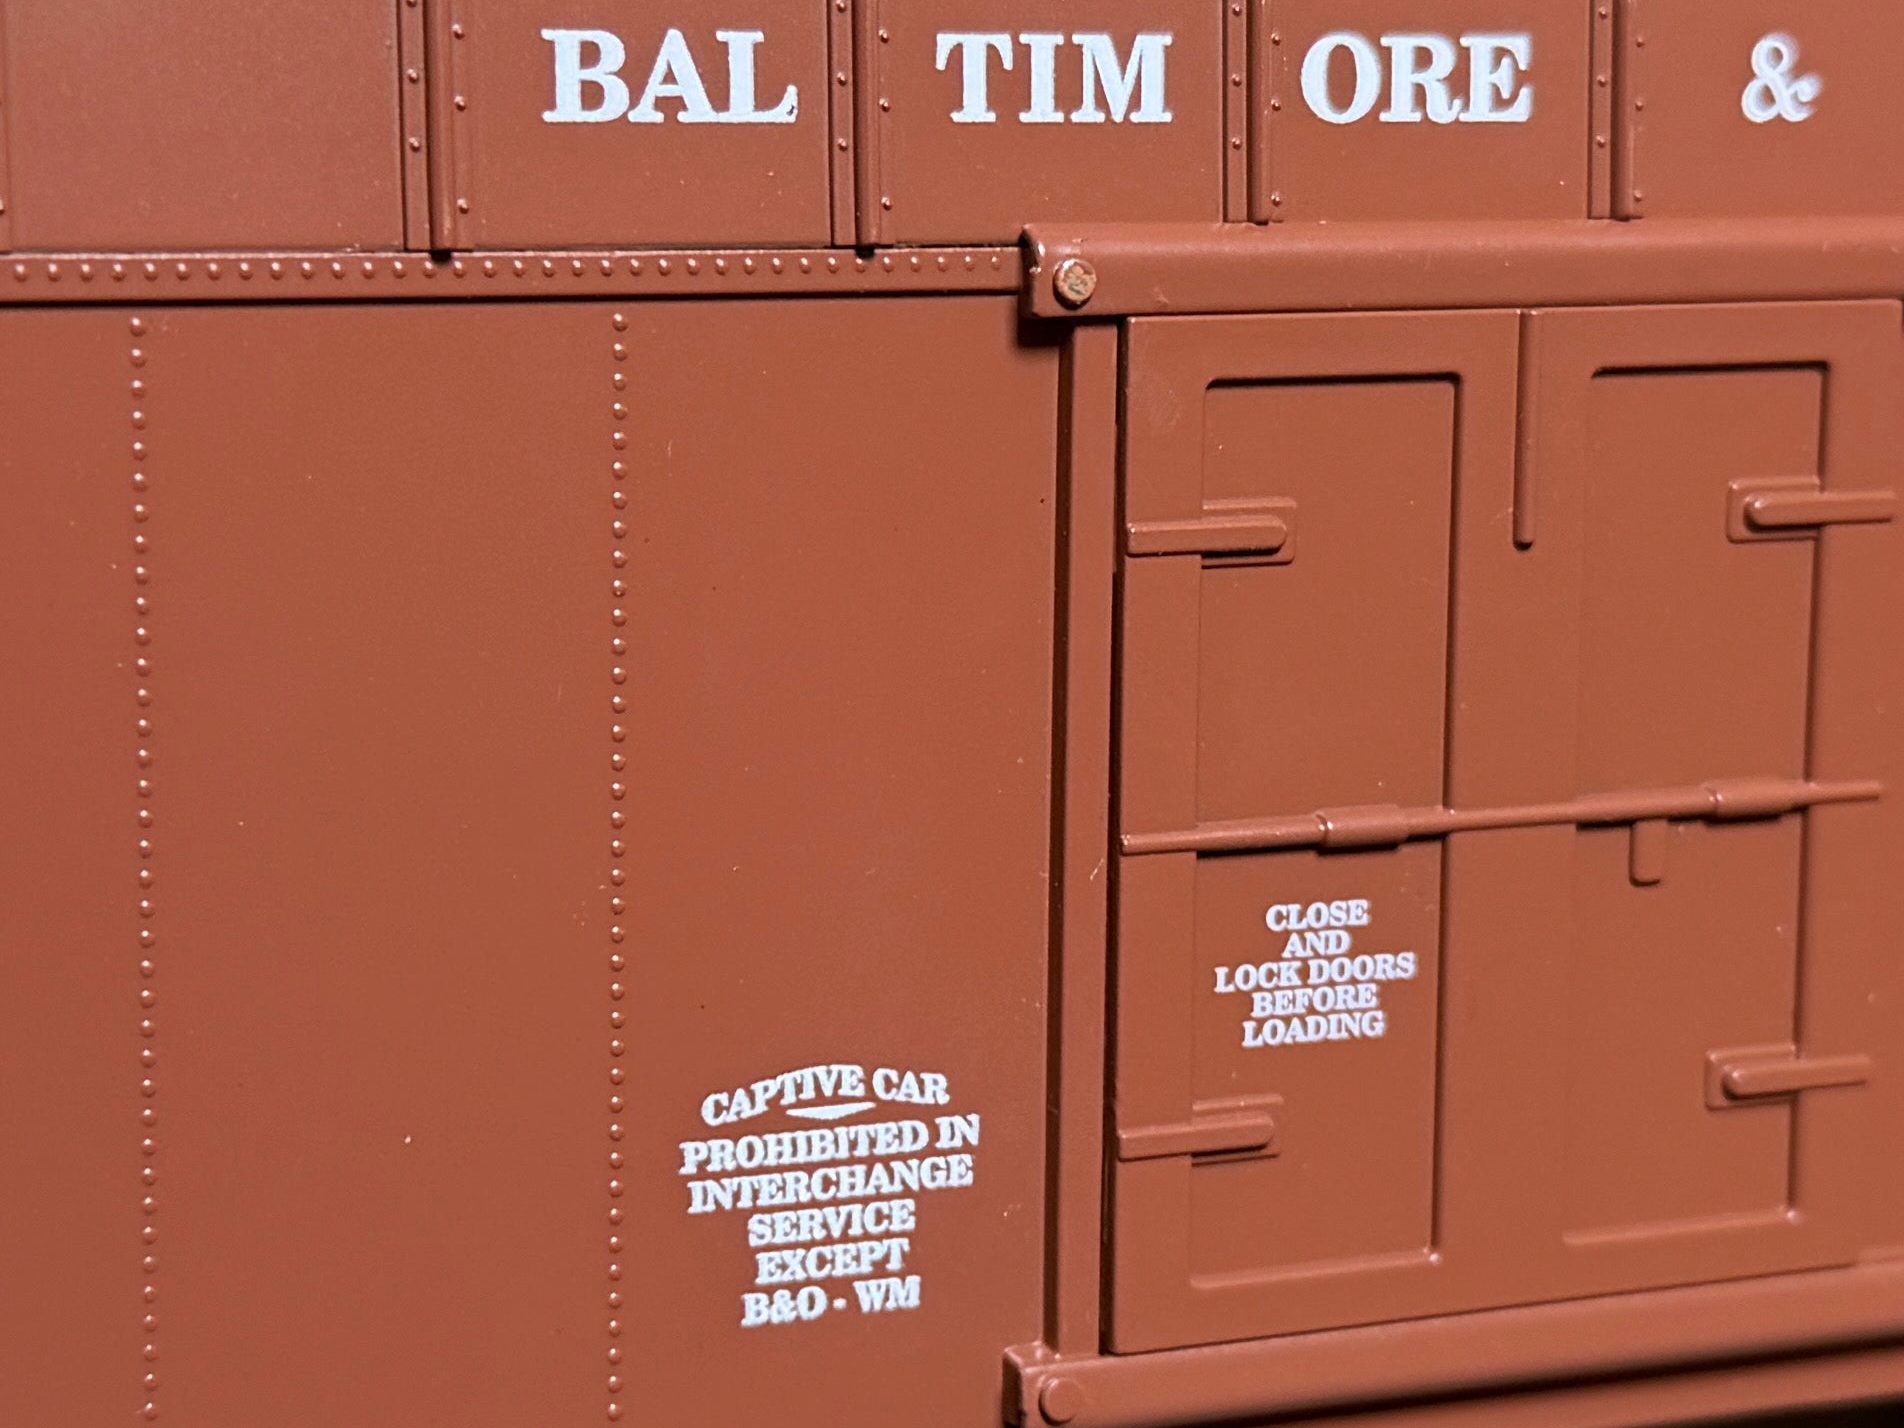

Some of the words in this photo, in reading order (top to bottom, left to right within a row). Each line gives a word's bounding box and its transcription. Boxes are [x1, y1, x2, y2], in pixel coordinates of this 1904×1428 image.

[541, 28, 798, 123] BAL
[936, 32, 1173, 123] TIM
[1301, 31, 1533, 124] ORE
[1741, 33, 1821, 123] &
[1266, 899, 1370, 932] CLOSE
[1282, 930, 1351, 958] AND
[1214, 961, 1306, 993] LOCK
[1307, 952, 1417, 988] DOORS
[1251, 983, 1379, 1018] BEFORE
[1242, 1010, 1386, 1047] LOADING
[701, 1064, 865, 1126] CAPTIVE
[872, 1068, 950, 1105] CAR
[679, 1120, 929, 1175] PROHIBITED
[934, 1113, 980, 1149] IN
[687, 1154, 973, 1214] INTERCHANGE
[748, 1199, 916, 1247] SERVICE
[755, 1238, 910, 1285] EXCEPT
[741, 1286, 828, 1327] B&O
[853, 1275, 921, 1313] WM
